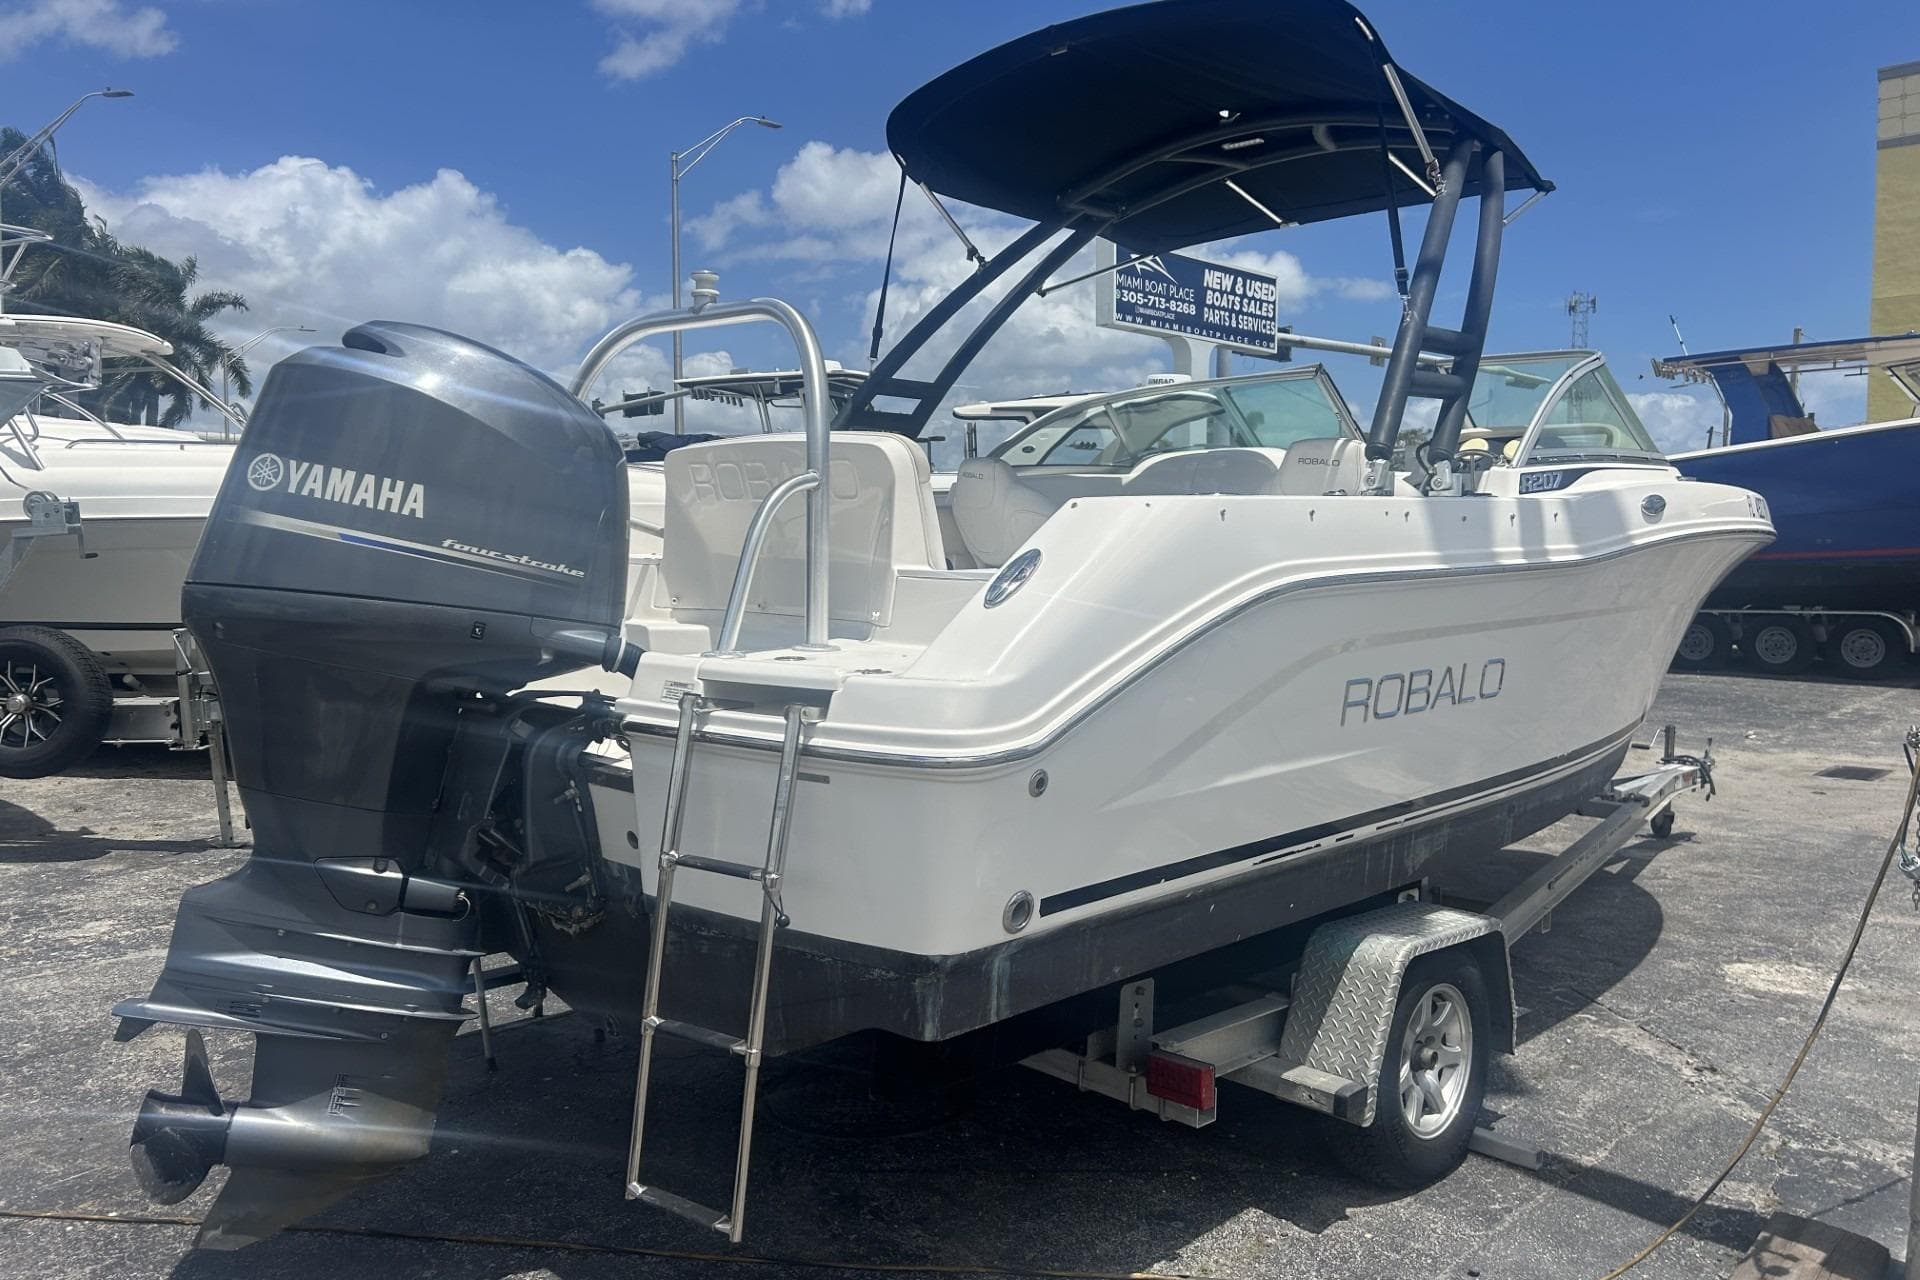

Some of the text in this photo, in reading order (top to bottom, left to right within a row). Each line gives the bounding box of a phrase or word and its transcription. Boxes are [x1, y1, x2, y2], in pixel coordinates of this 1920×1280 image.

[1116, 272, 1195, 302] MIAMI BOAT PLACE
[1203, 269, 1276, 302] NEW & USED
[1121, 289, 1196, 315] 305-713-8268
[1206, 289, 1274, 318] BOATS SALES
[1203, 307, 1275, 335] PARTS & SERVICES
[1297, 457, 1341, 467] ROBALO
[286, 459, 425, 519] YAMAHA
[688, 459, 860, 502] ROBO
[1521, 471, 1563, 491] R207
[441, 538, 585, 578] fourstroke
[1340, 657, 1505, 727] ROBALO
